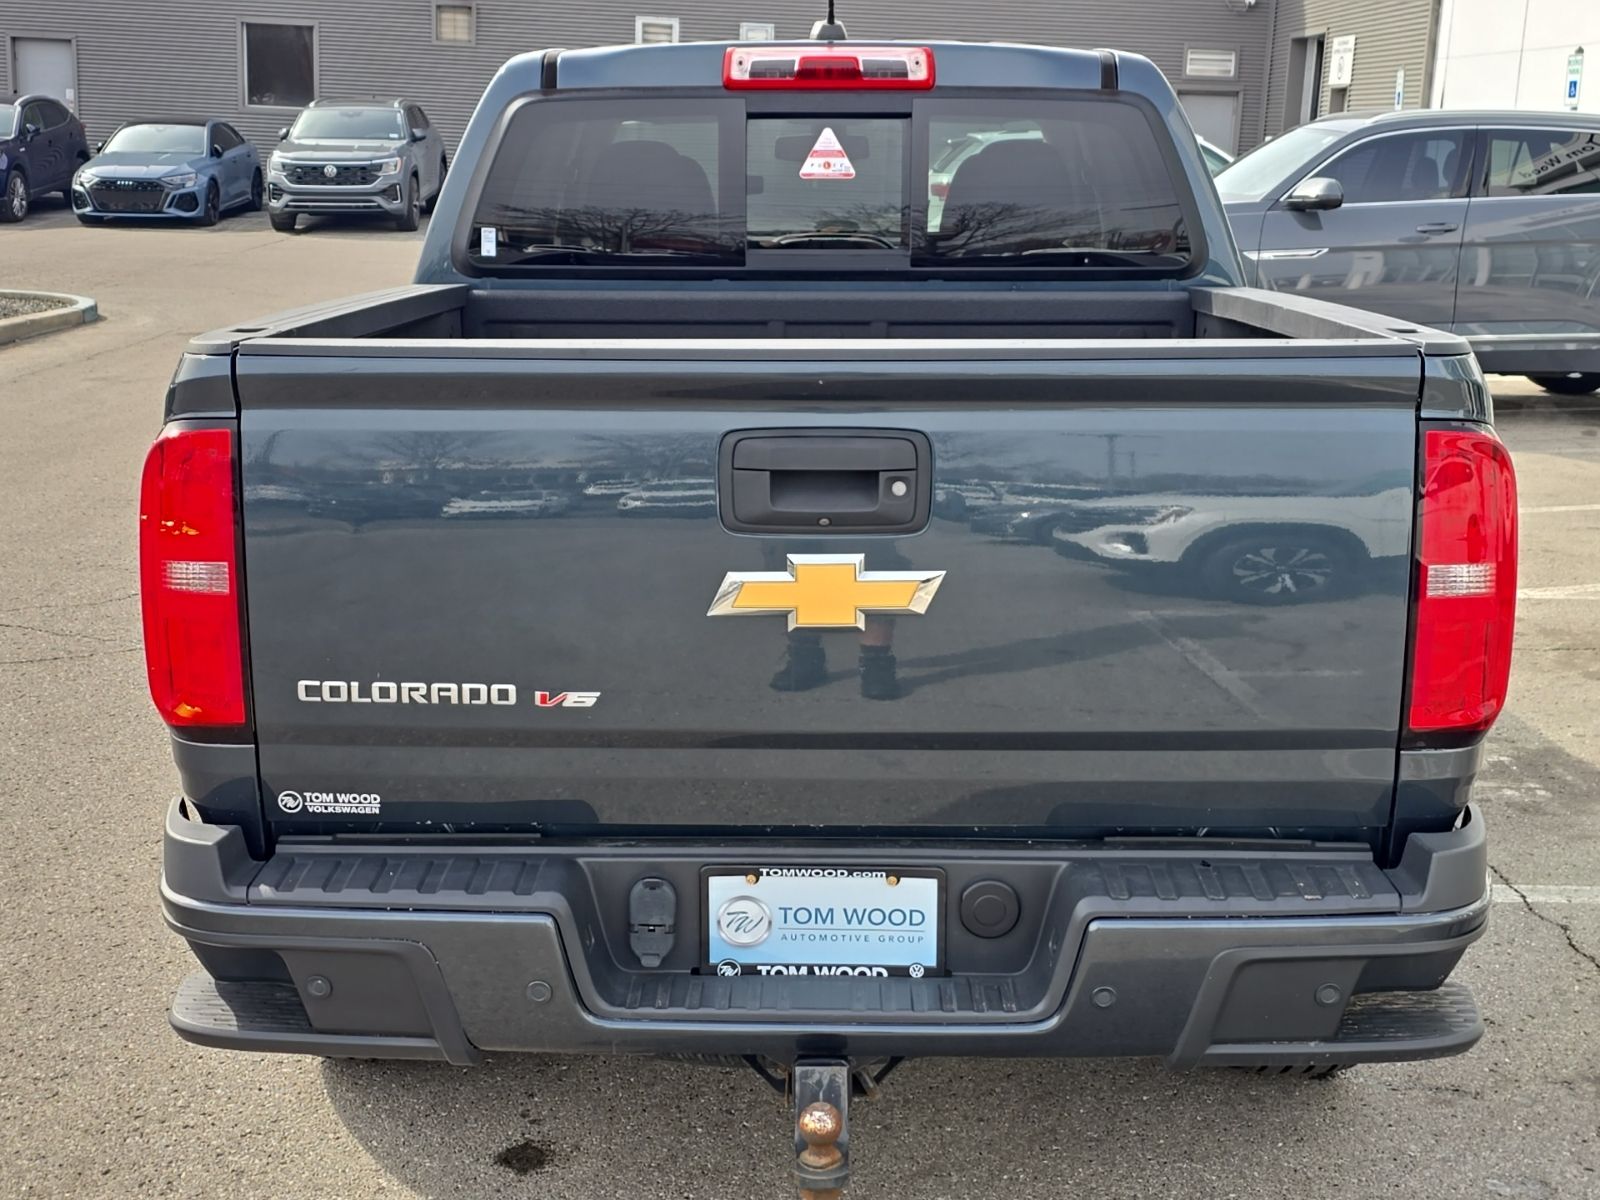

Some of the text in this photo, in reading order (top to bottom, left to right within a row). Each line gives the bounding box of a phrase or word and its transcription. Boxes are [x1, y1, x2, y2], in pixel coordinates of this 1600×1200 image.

[298, 680, 601, 707] COLORADO V6
[303, 792, 381, 804] TOM WOOD
[306, 805, 380, 814] VOLKSWAGEN
[759, 868, 887, 878] TOMWOOD.com
[778, 907, 925, 926] TOM WOOD
[780, 933, 924, 943] AUTOMOTIVE GROUP
